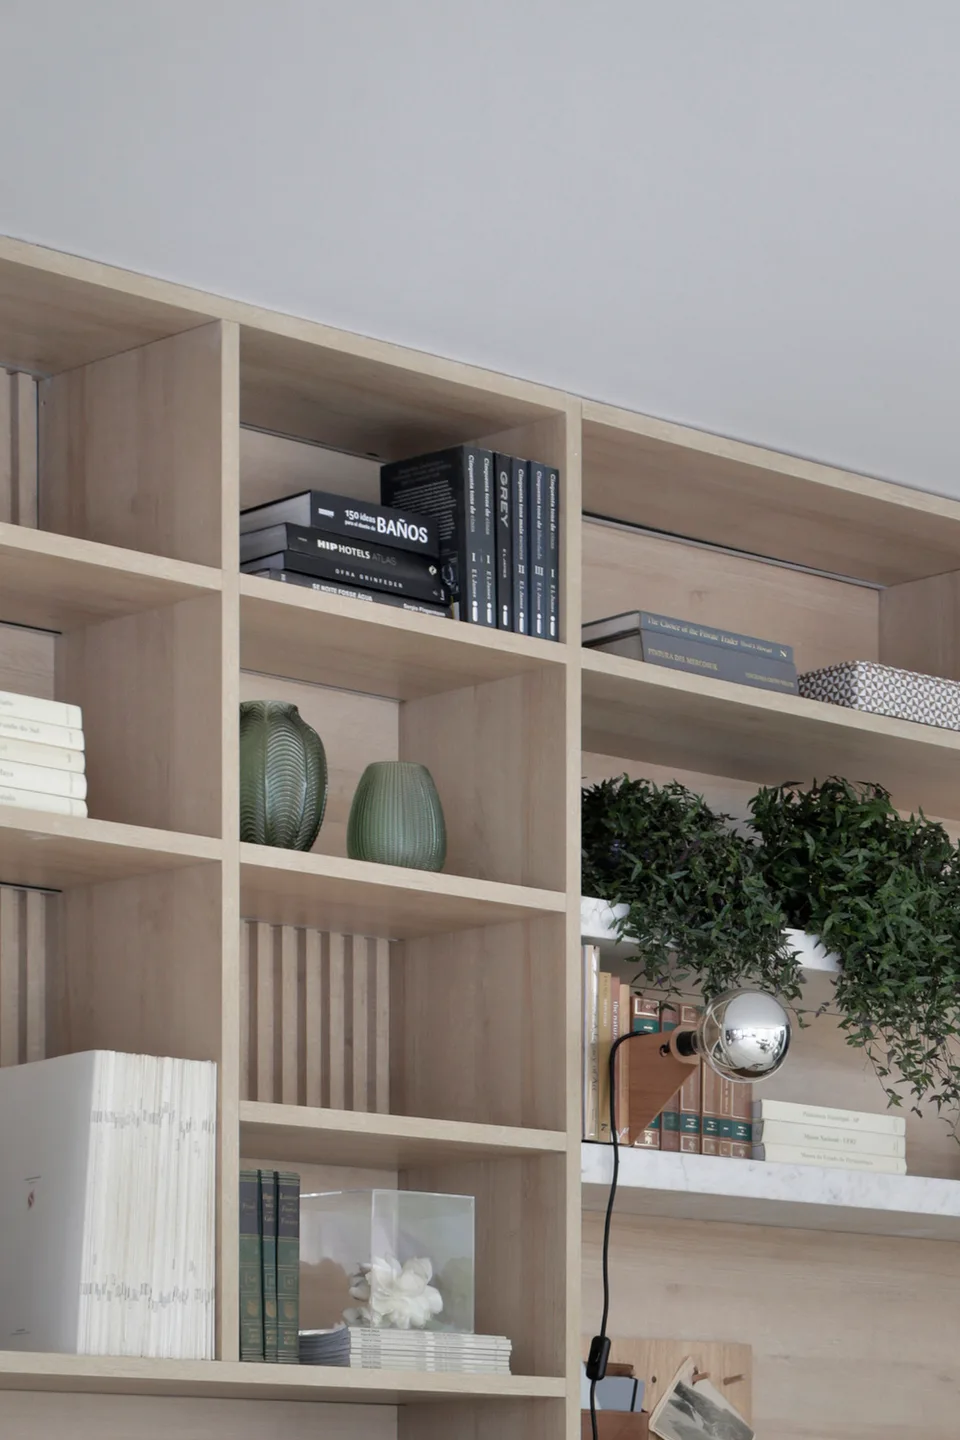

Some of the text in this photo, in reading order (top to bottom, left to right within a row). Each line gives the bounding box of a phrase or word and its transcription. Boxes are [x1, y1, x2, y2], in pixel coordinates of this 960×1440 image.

[500, 471, 508, 528] GREY
[344, 509, 359, 520] 150
[360, 512, 376, 524] ideas
[377, 516, 428, 543] BAÑOS
[317, 539, 397, 566] HIP HOTELS ATLAS
[320, 584, 338, 594] NOITE
[338, 587, 357, 598] FOSSE
